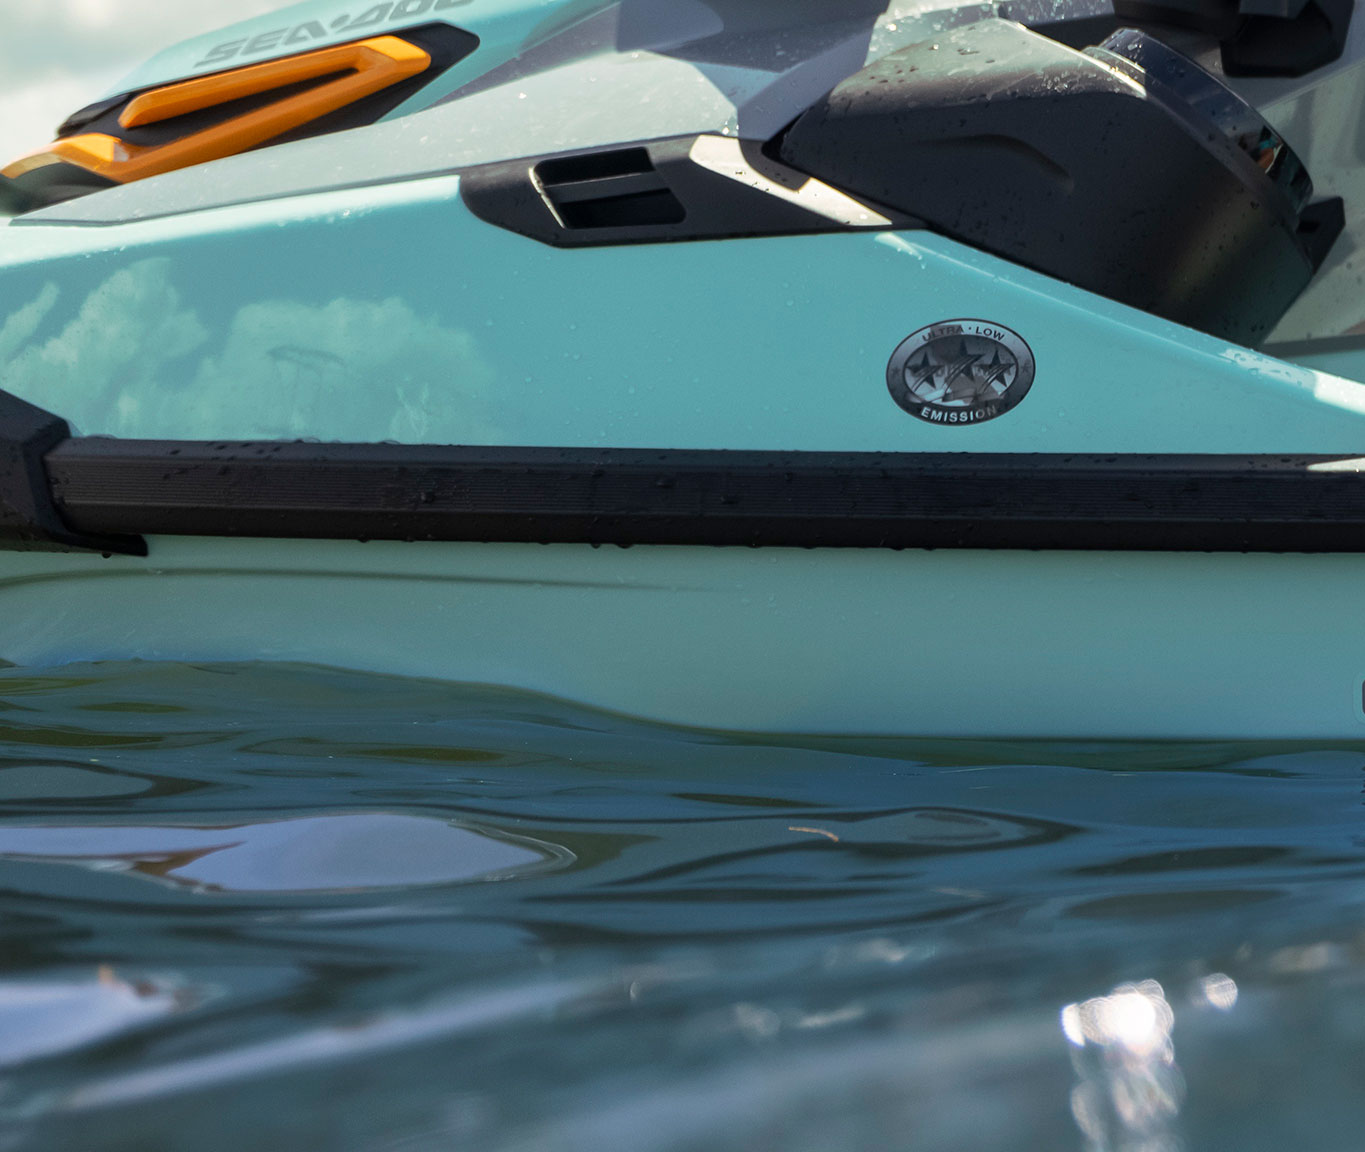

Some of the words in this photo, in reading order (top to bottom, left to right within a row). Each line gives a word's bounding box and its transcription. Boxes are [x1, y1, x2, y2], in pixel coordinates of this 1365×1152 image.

[921, 324, 965, 343] ULTRA
[975, 325, 1006, 342] LOW
[920, 405, 998, 424] EMISSION
